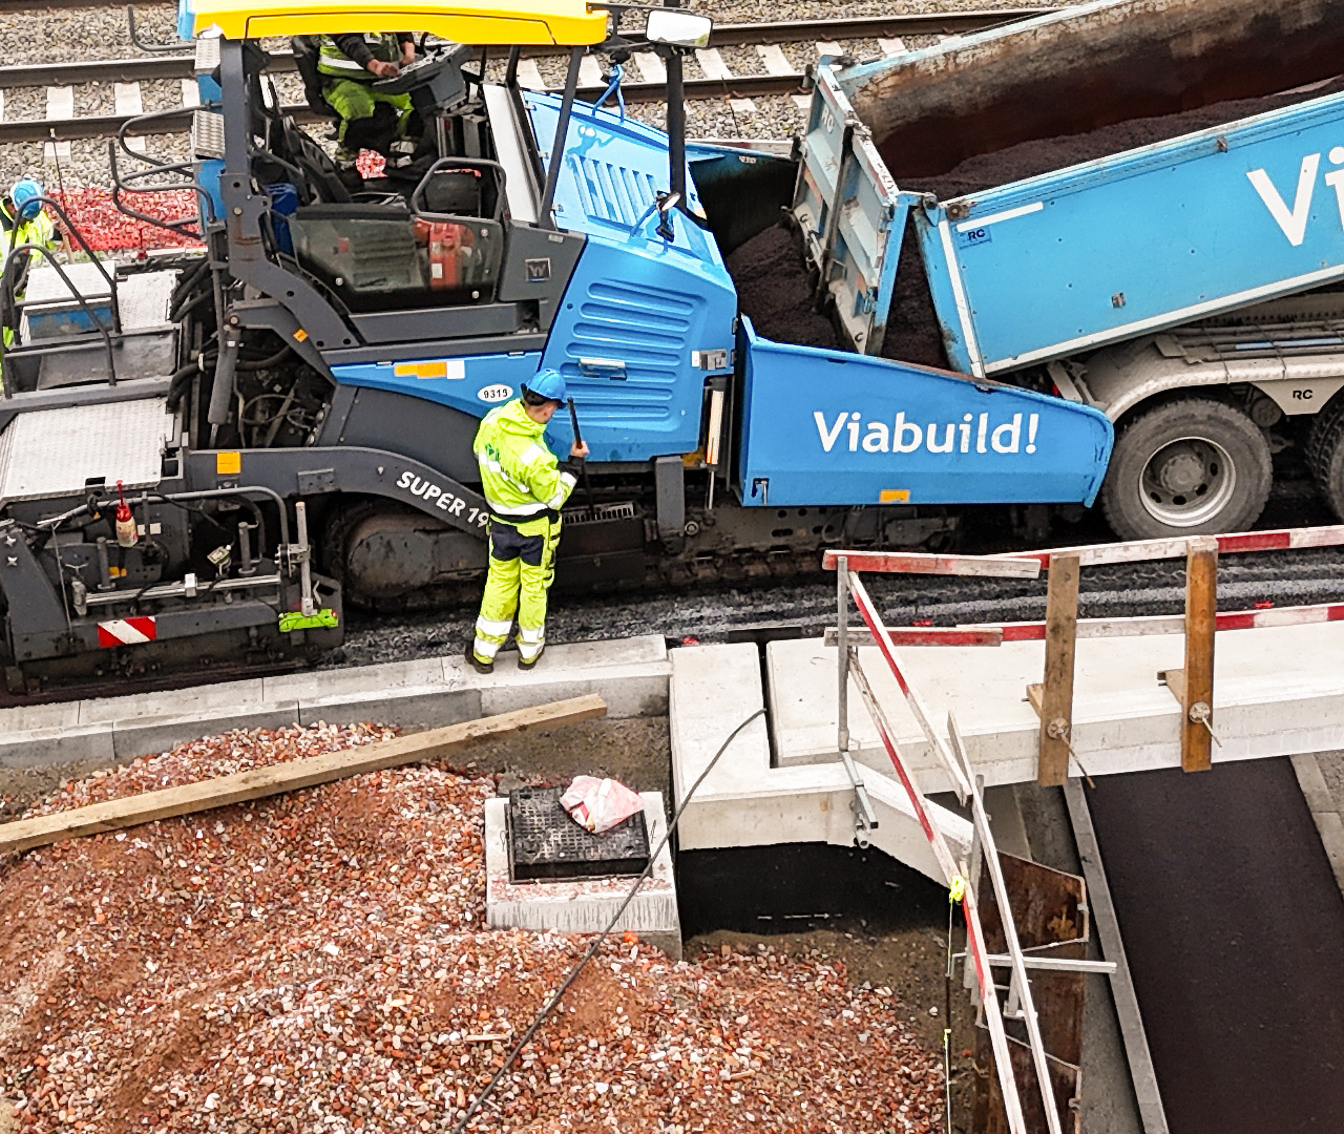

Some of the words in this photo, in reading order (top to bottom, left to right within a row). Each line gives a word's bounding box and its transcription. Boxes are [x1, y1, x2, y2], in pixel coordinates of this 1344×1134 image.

[967, 228, 986, 241] RC
[1292, 389, 1314, 401] RC
[813, 411, 1040, 454] Viabuild!
[396, 470, 467, 517] SUPER
[467, 506, 491, 528] 19
